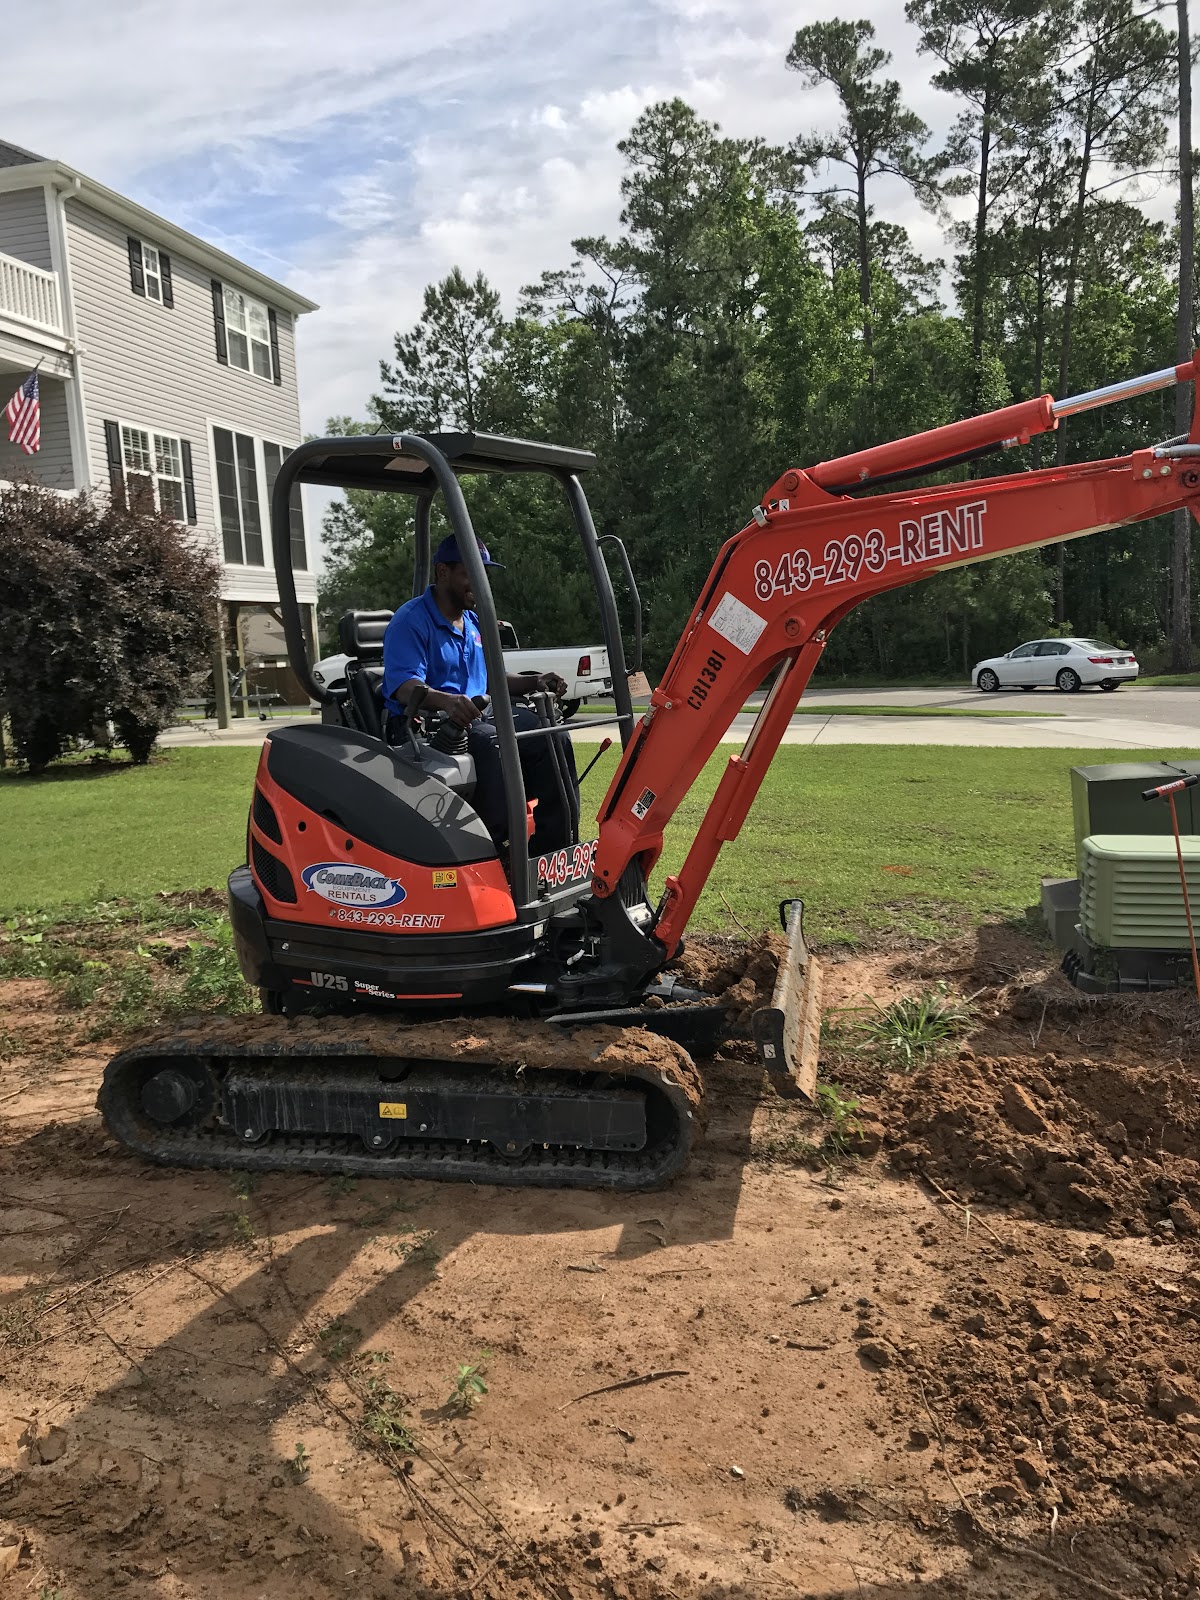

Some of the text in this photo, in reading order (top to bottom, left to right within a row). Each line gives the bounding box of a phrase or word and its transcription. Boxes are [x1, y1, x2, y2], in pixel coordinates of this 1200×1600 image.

[754, 500, 987, 601] 843-293-RENT
[687, 649, 726, 710] CB1381
[328, 890, 377, 902] RENTALS
[332, 885, 371, 893] EQUIPMENT
[338, 908, 445, 929] 843-293-RENT
[310, 971, 349, 991] U25
[354, 980, 379, 991] Super
[368, 989, 395, 999] Series
